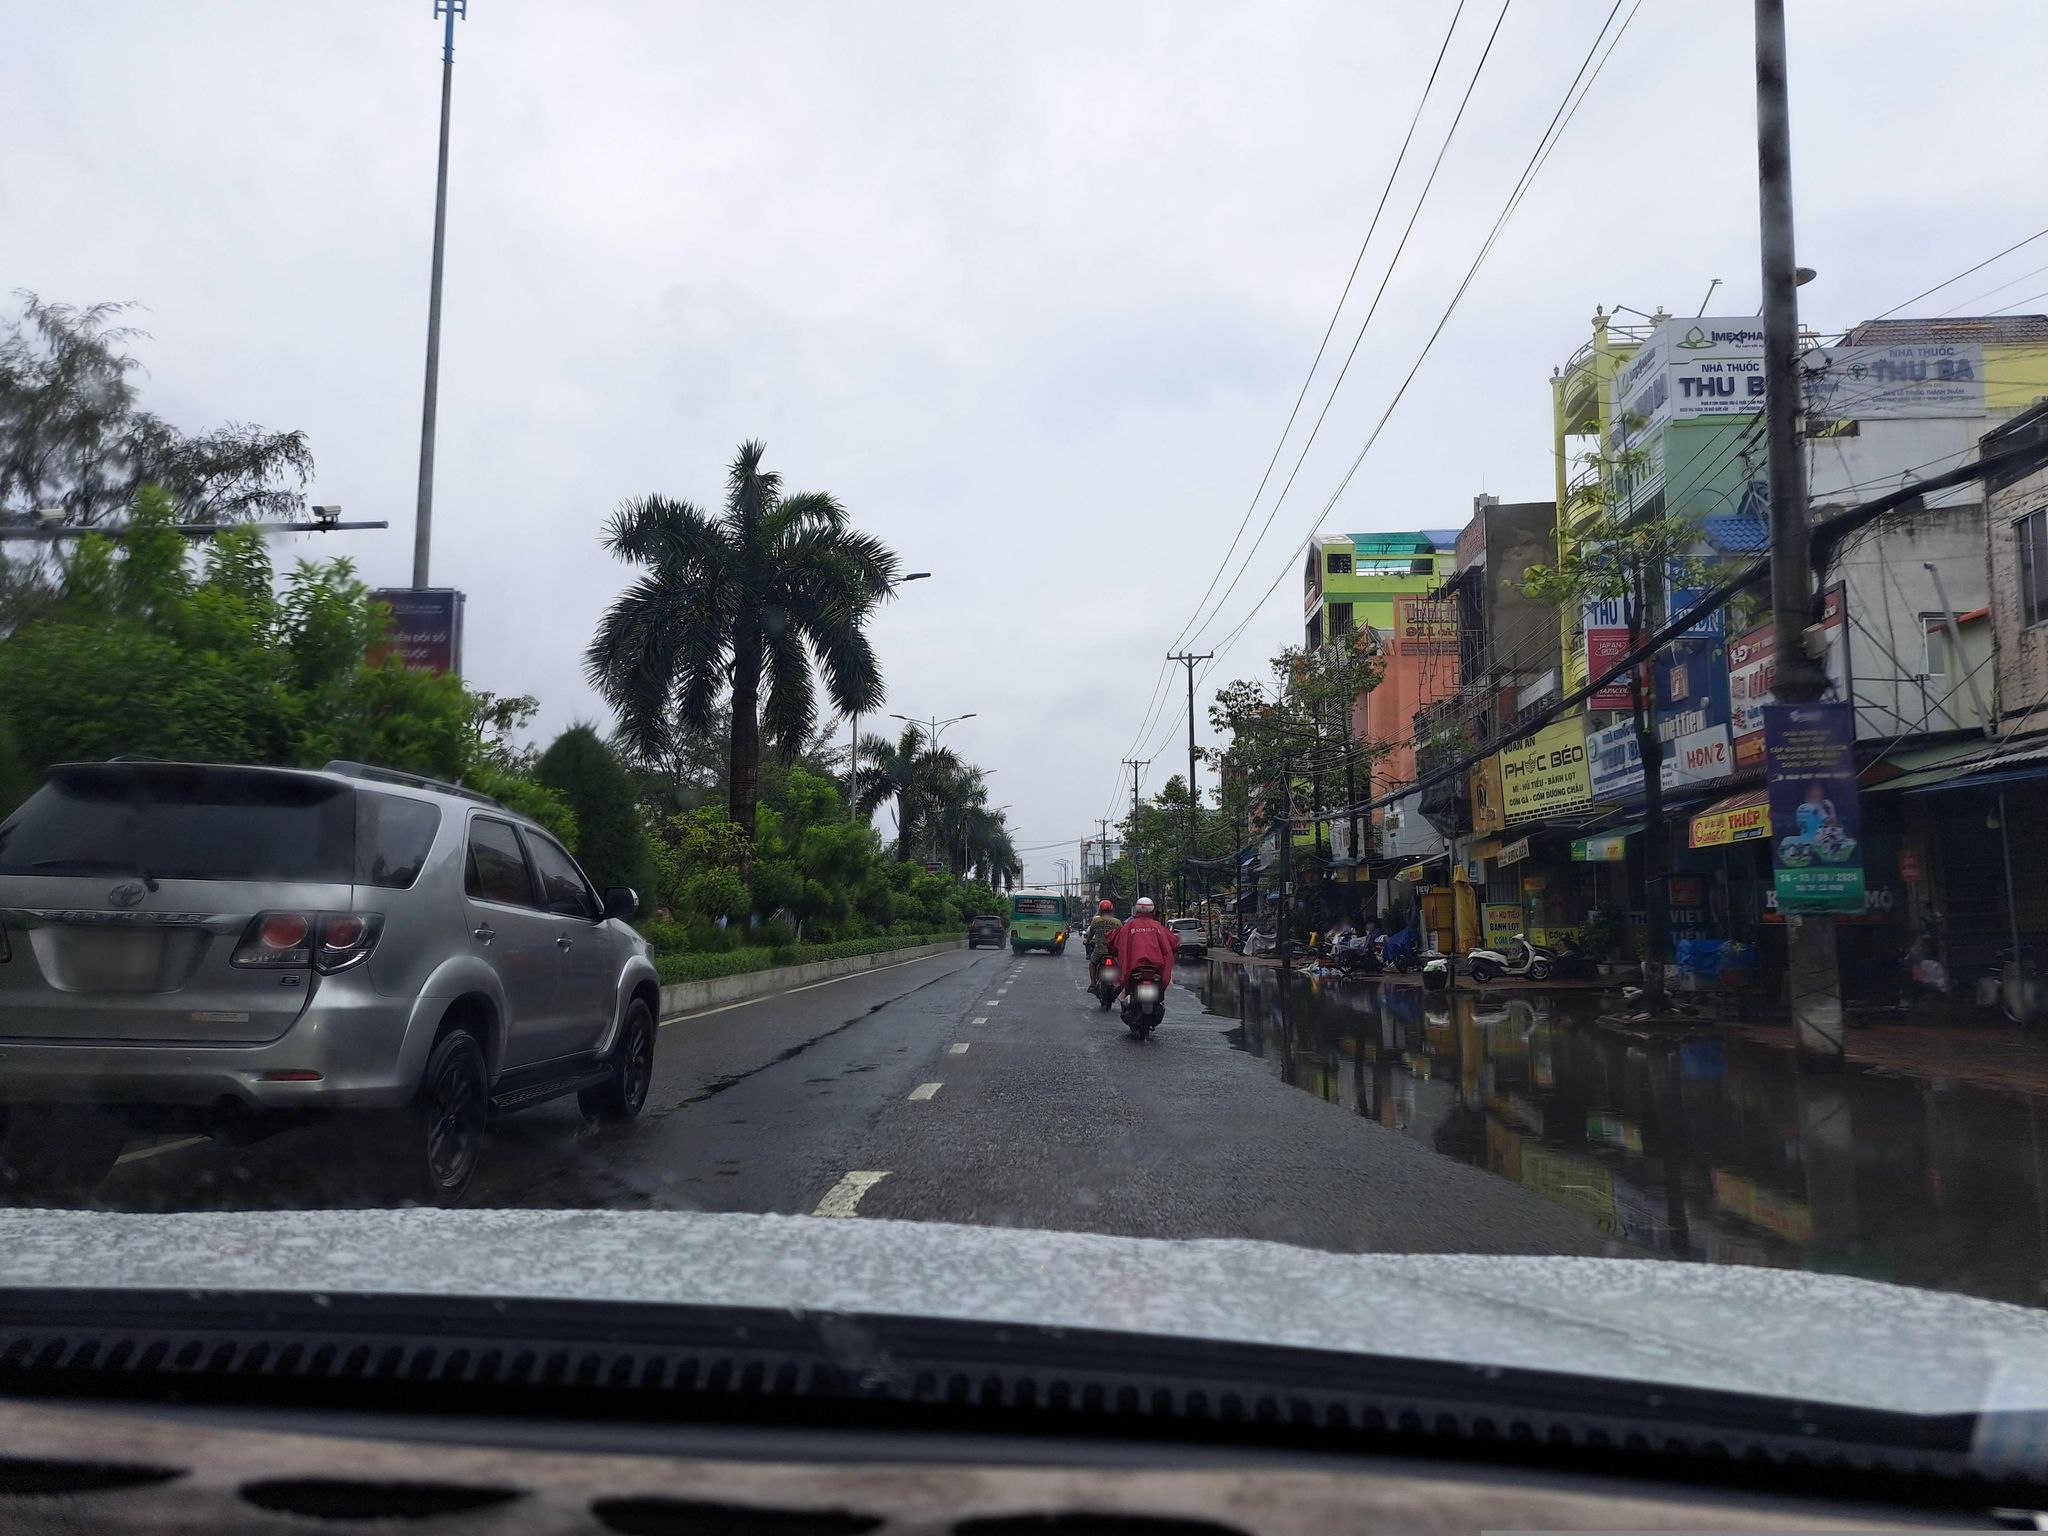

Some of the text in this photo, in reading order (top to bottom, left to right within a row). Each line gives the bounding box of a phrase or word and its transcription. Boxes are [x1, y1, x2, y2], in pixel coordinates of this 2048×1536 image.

[1701, 359, 1760, 373] NHÀ THUỐC
[1872, 358, 1975, 382] THU BA
[1679, 375, 1735, 398] THU
[1592, 601, 1618, 625] THU
[1550, 744, 1584, 768] BÉO
[42, 910, 201, 923] FORTUNER
[283, 976, 298, 984] G
